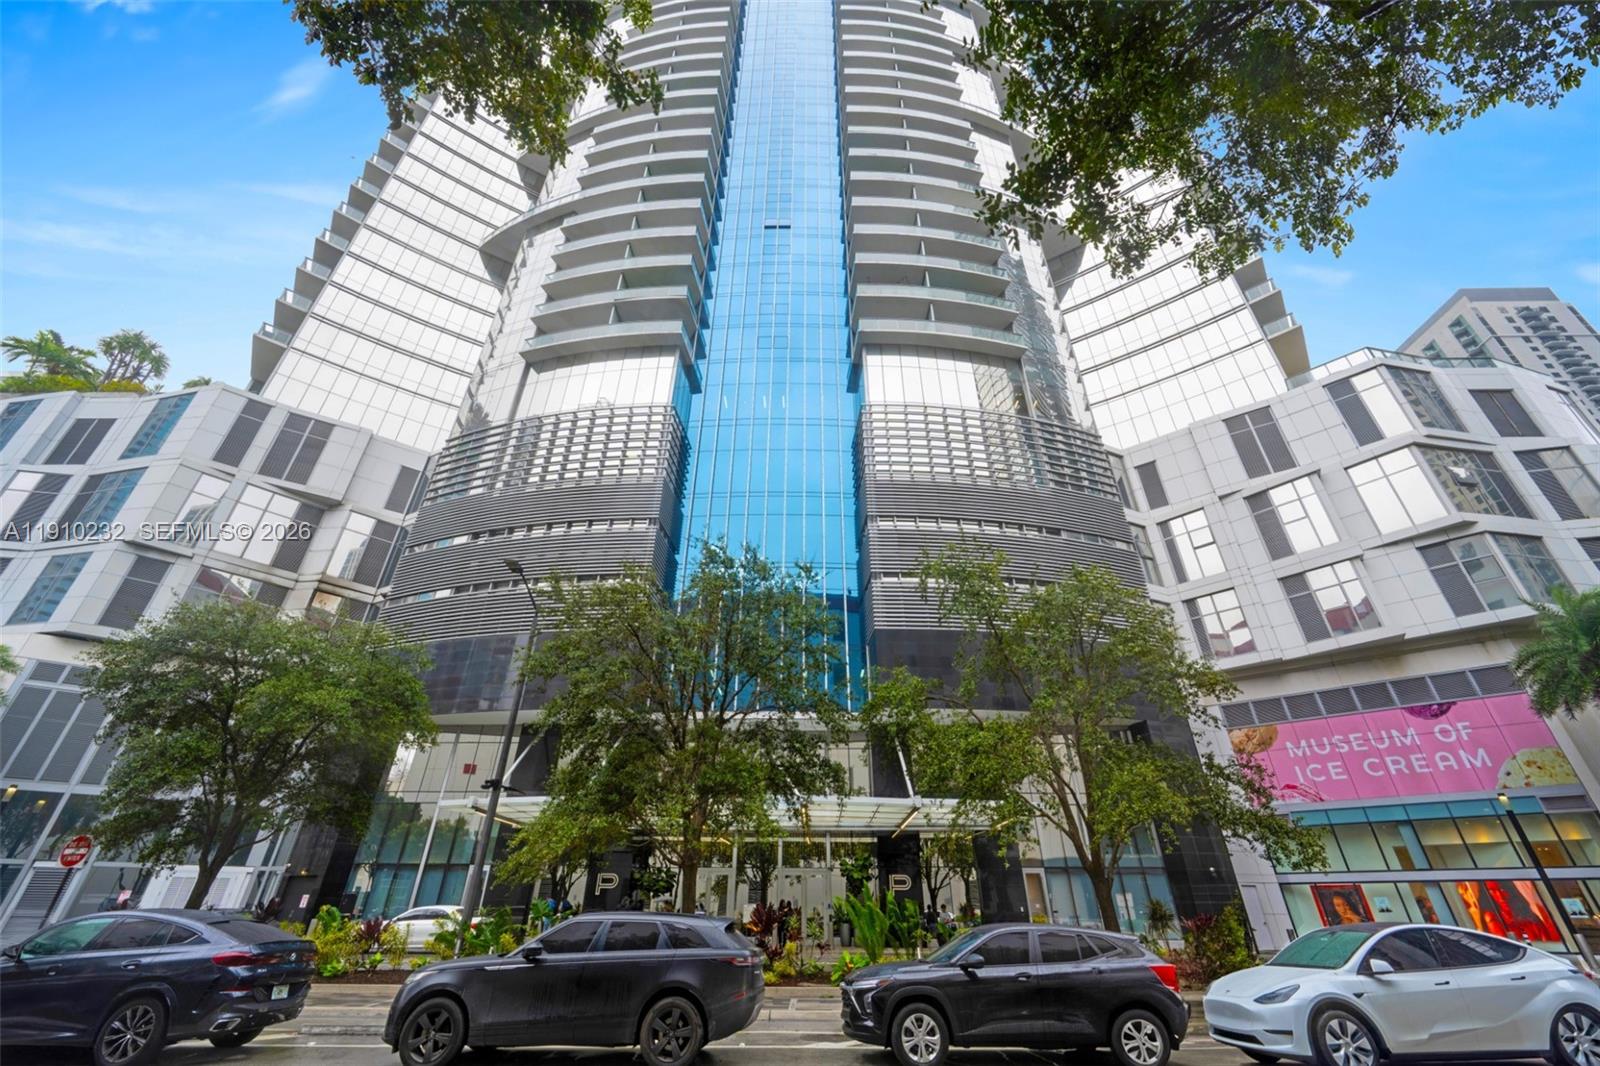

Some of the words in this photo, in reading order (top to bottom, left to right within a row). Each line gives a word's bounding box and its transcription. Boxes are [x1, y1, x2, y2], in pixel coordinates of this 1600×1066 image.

[1285, 727, 1421, 758] MUSEUM
[1433, 721, 1473, 743] OF
[1294, 761, 1348, 784] ICE
[1362, 747, 1493, 777] CREAM
[595, 873, 619, 896] P
[889, 874, 912, 896] P
